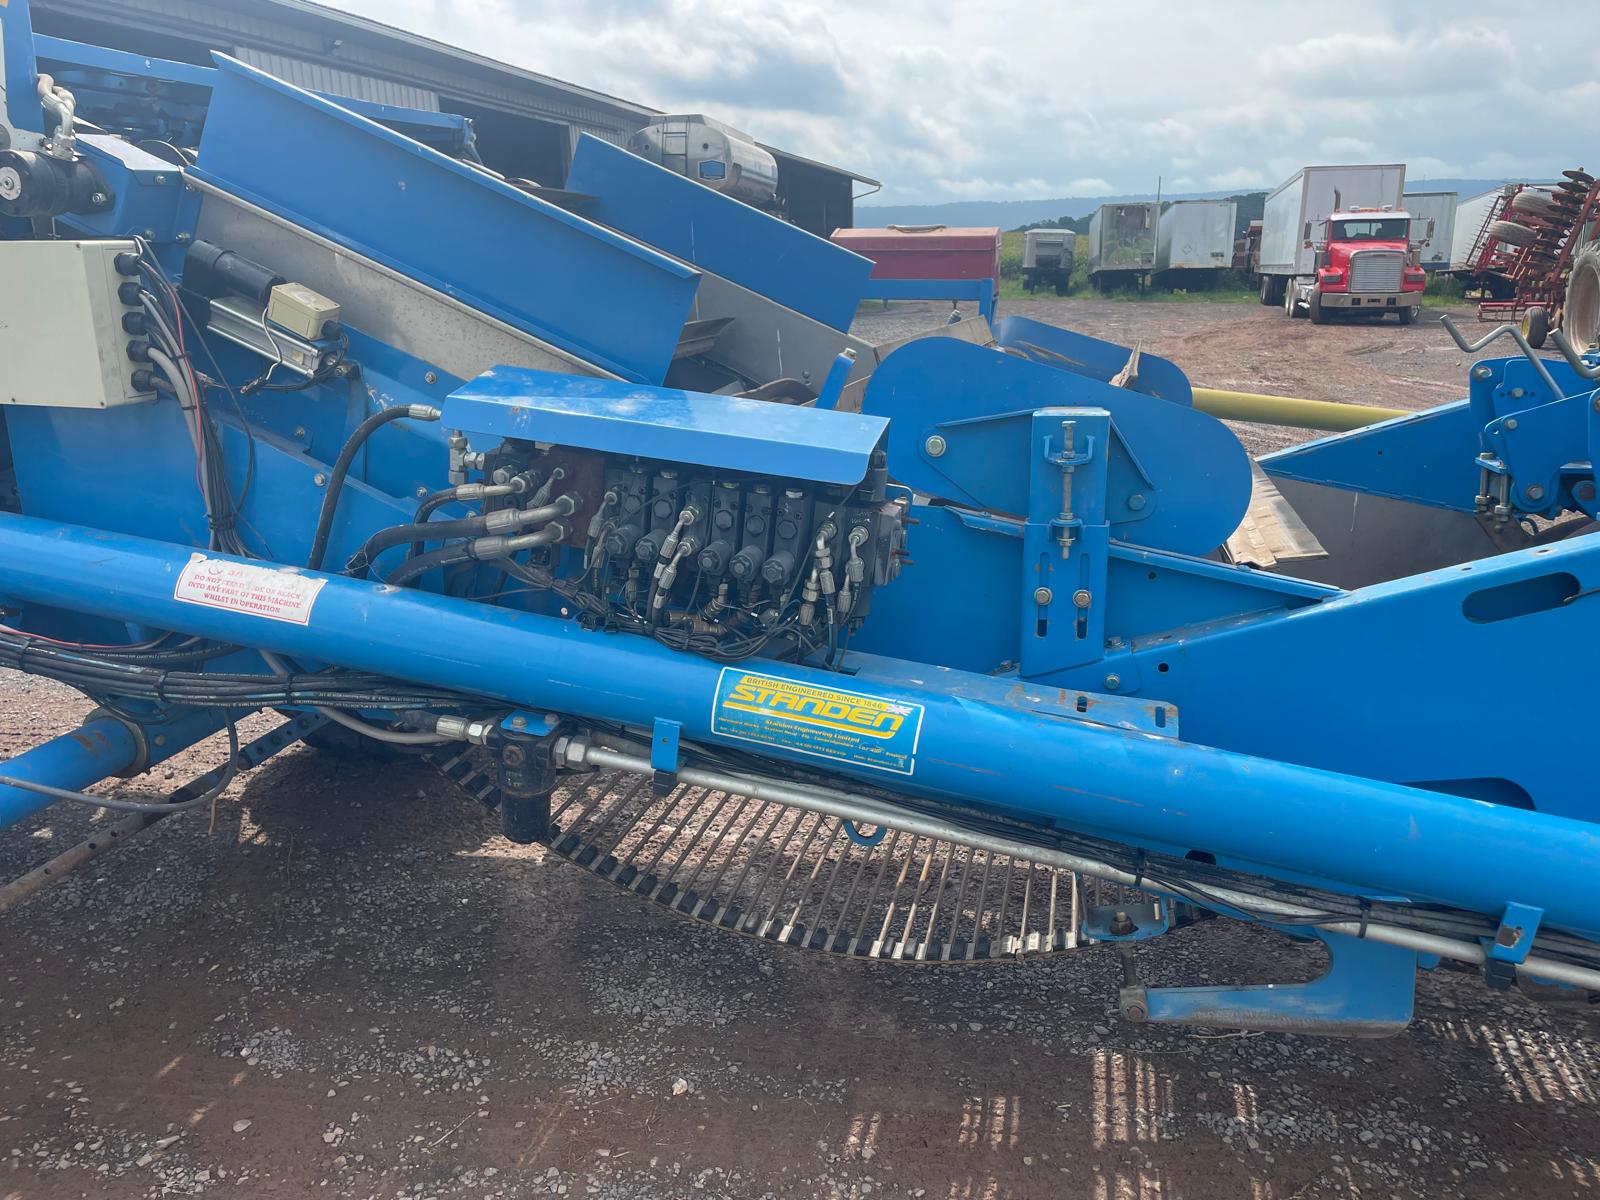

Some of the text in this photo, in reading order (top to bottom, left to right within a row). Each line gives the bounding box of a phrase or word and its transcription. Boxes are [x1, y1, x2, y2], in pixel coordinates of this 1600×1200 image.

[206, 576, 222, 584] NOT
[188, 581, 206, 589] INTO
[206, 584, 222, 592] ANY
[250, 592, 266, 602] THIS
[267, 596, 302, 608] MACHINE
[203, 592, 281, 613] WHILST IN OPERATION
[746, 677, 883, 709] BRITISH ENGINEERED SINCE 1846
[729, 684, 904, 731] STANDEN
